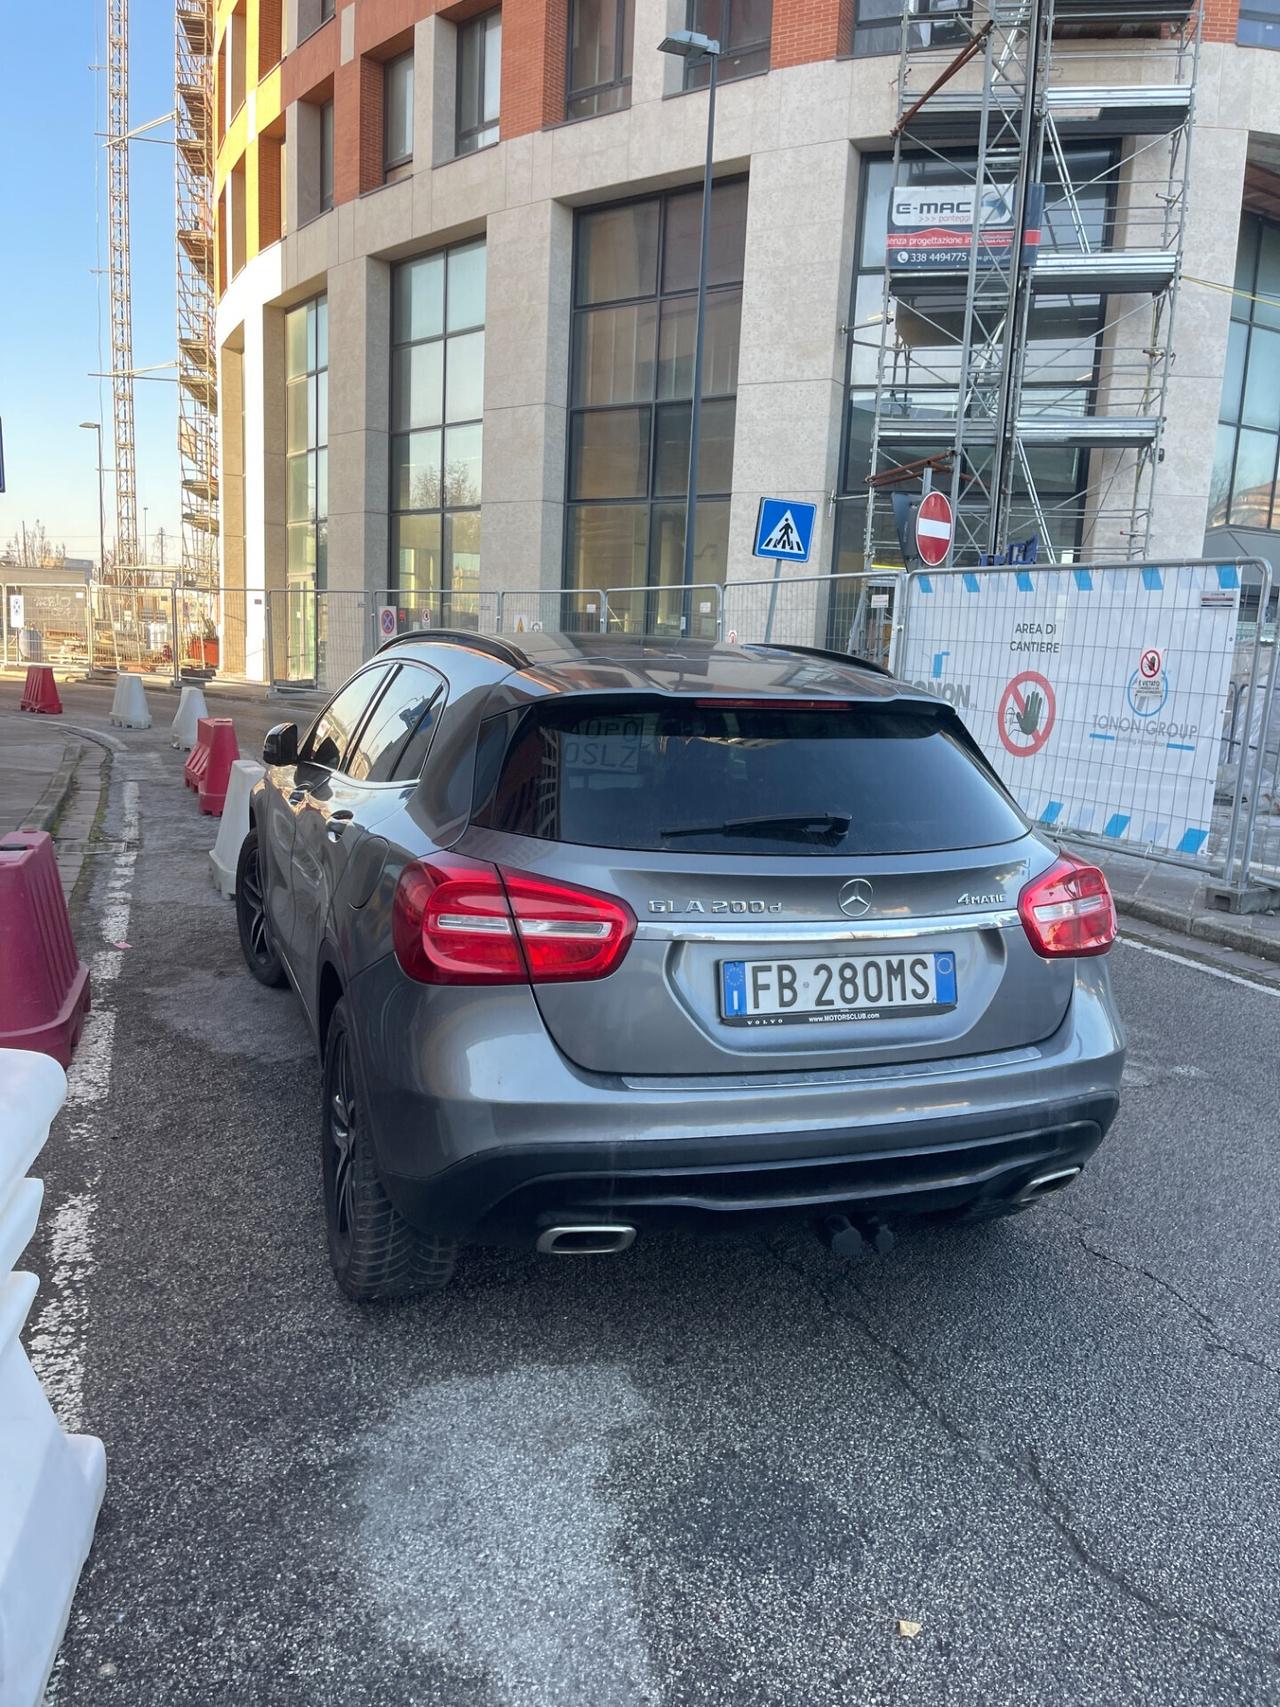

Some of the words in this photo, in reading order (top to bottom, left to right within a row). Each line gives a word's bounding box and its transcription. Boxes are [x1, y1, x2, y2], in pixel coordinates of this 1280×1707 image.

[896, 201, 972, 214] E-MAC
[909, 236, 963, 247] progettazione
[909, 253, 927, 262] 338
[929, 252, 967, 261] 4494775
[1014, 623, 1042, 634] AREA
[1045, 623, 1057, 634] DI
[1009, 641, 1060, 653] CANTIERE
[1145, 720, 1198, 740] GROUP
[957, 892, 1008, 905] 4MATIC
[648, 899, 705, 914] GLA
[751, 963, 798, 1010] FB
[813, 956, 930, 1007] 280MS
[746, 1017, 784, 1026] VOLVO
